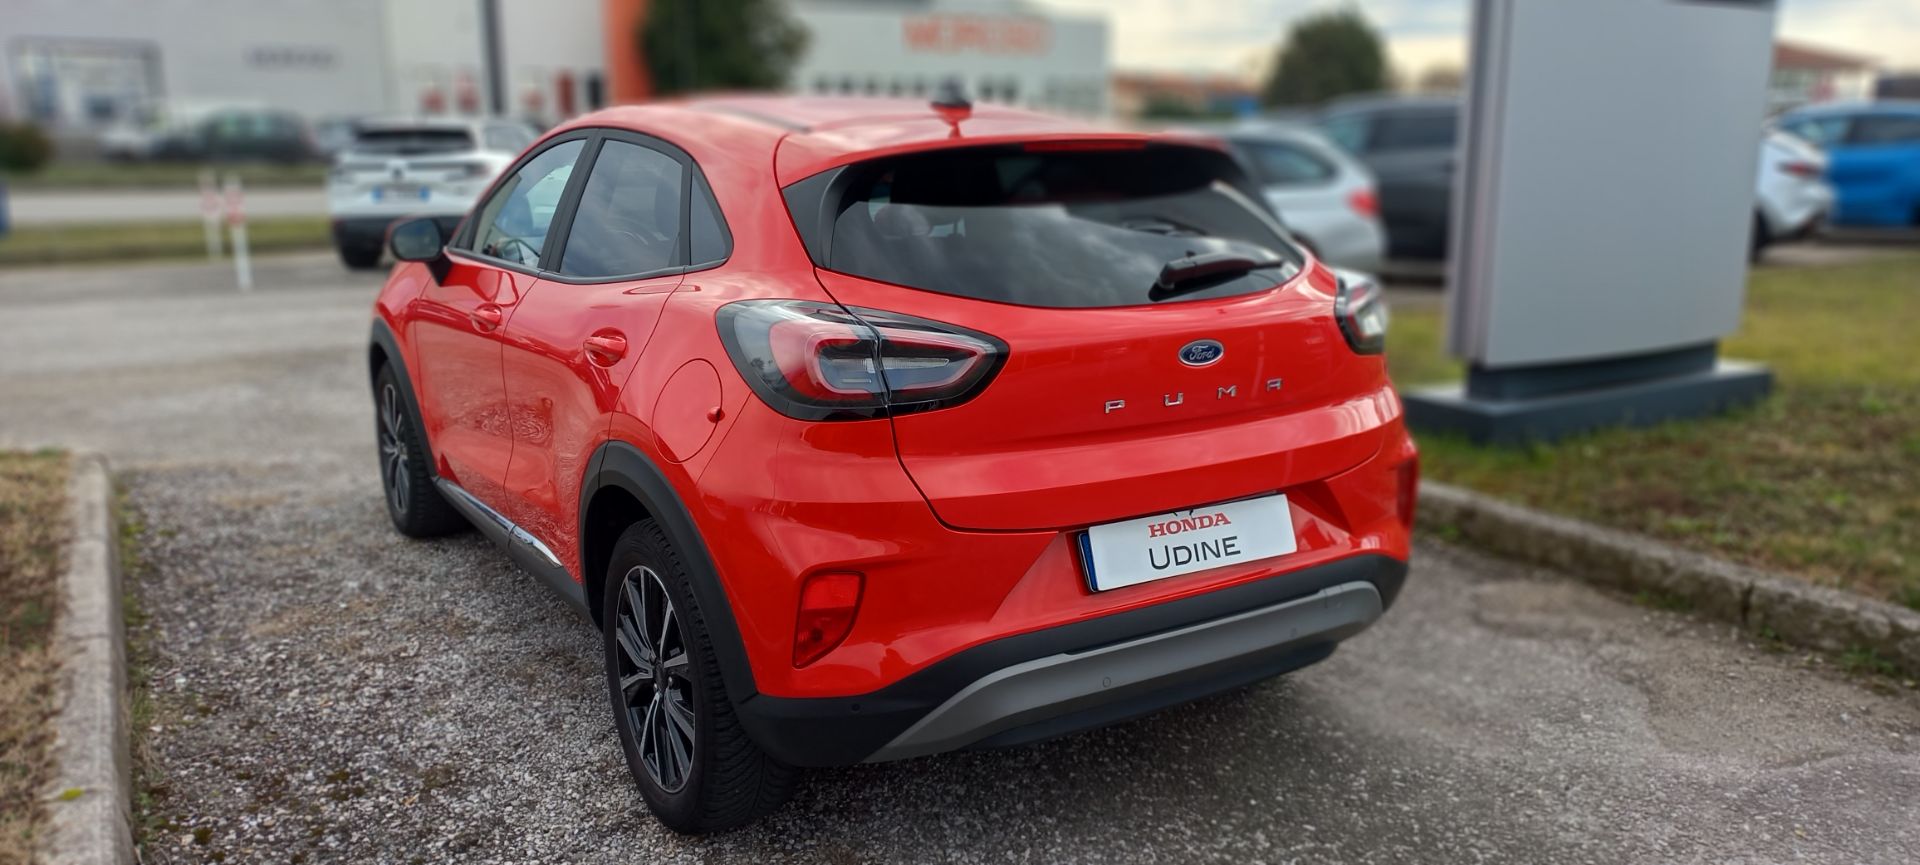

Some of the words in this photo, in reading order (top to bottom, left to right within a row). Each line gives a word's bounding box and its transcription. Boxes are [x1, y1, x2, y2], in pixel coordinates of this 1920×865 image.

[1189, 345, 1215, 360] Ford
[1105, 378, 1282, 414] PUMA
[1148, 512, 1231, 538] HONDA
[1149, 536, 1241, 570] UDINE
